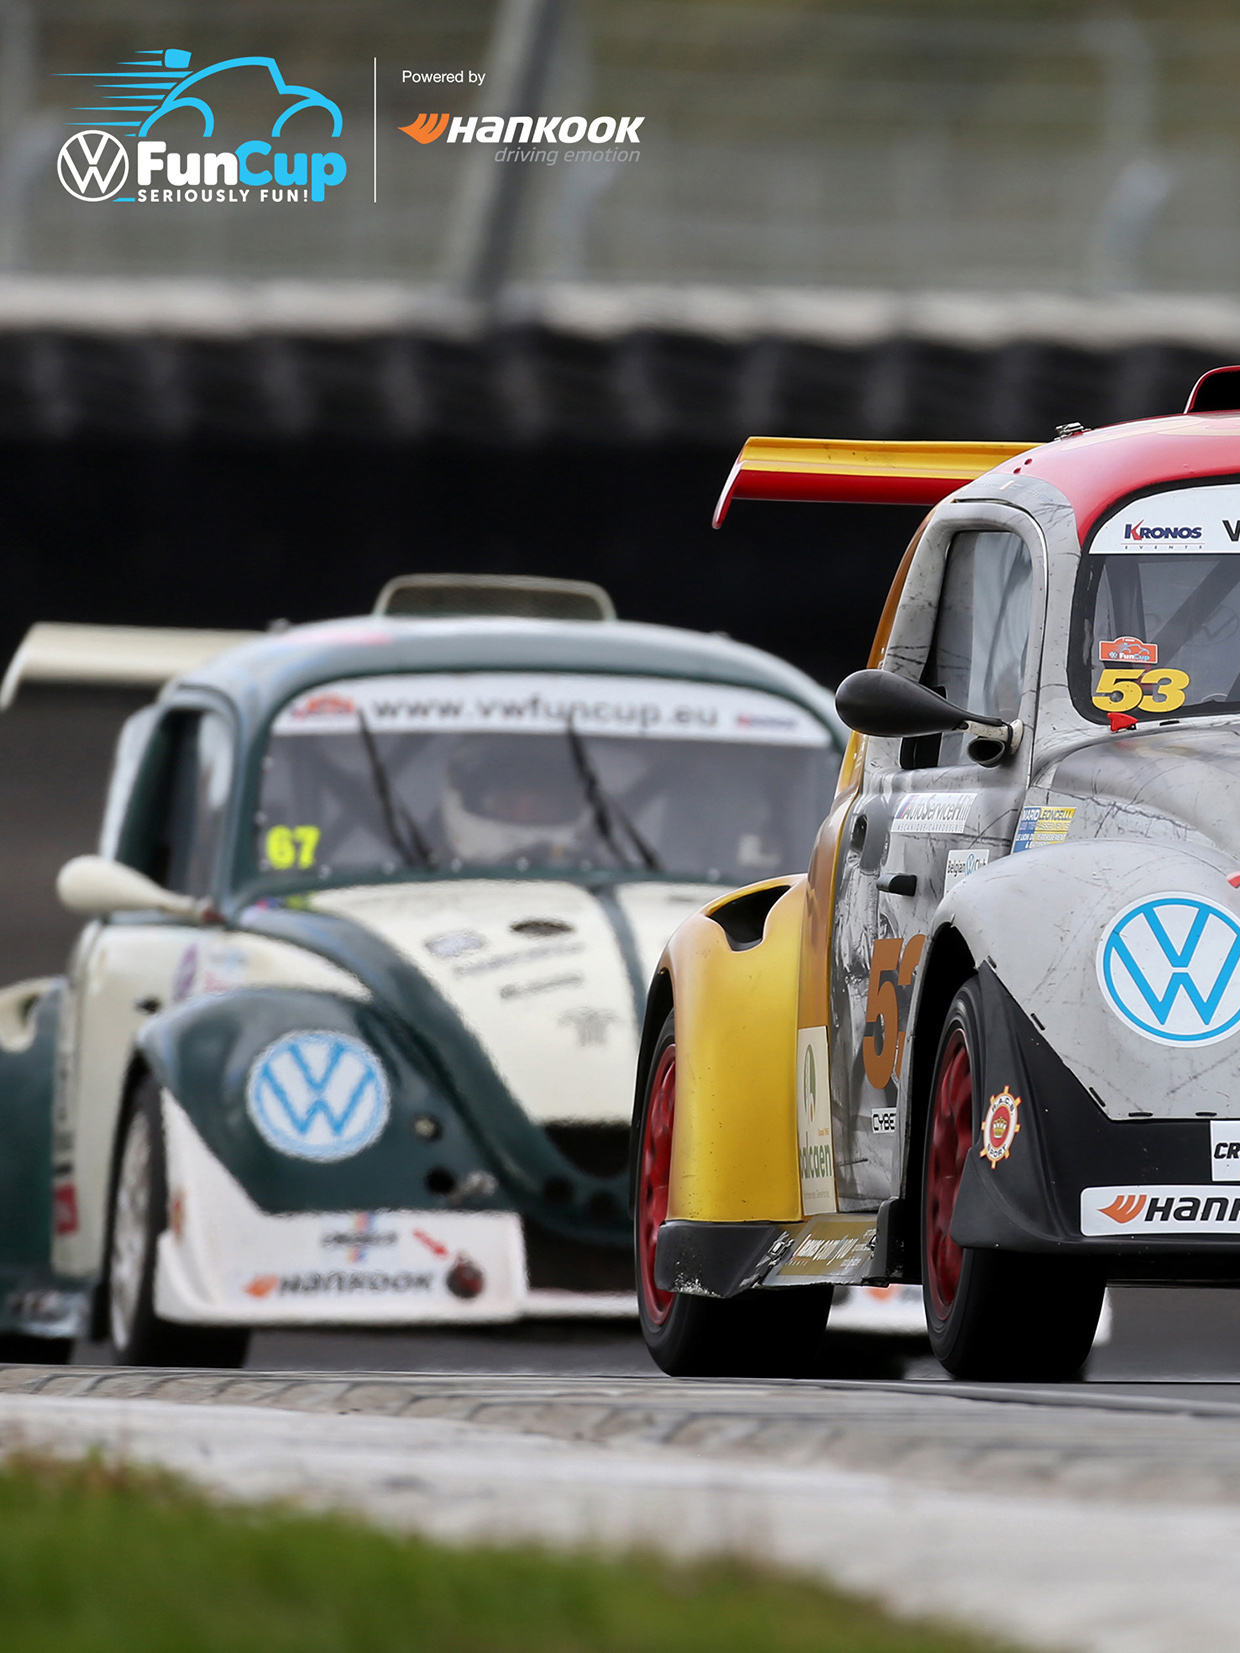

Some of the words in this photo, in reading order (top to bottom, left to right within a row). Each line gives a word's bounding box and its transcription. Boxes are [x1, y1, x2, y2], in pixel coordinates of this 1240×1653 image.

[1124, 519, 1202, 541] KRONOS
[1119, 652, 1151, 661] FunCup
[1092, 668, 1191, 713] 53
[371, 692, 718, 734] www.vwfuncup.eu
[265, 825, 320, 868] 67
